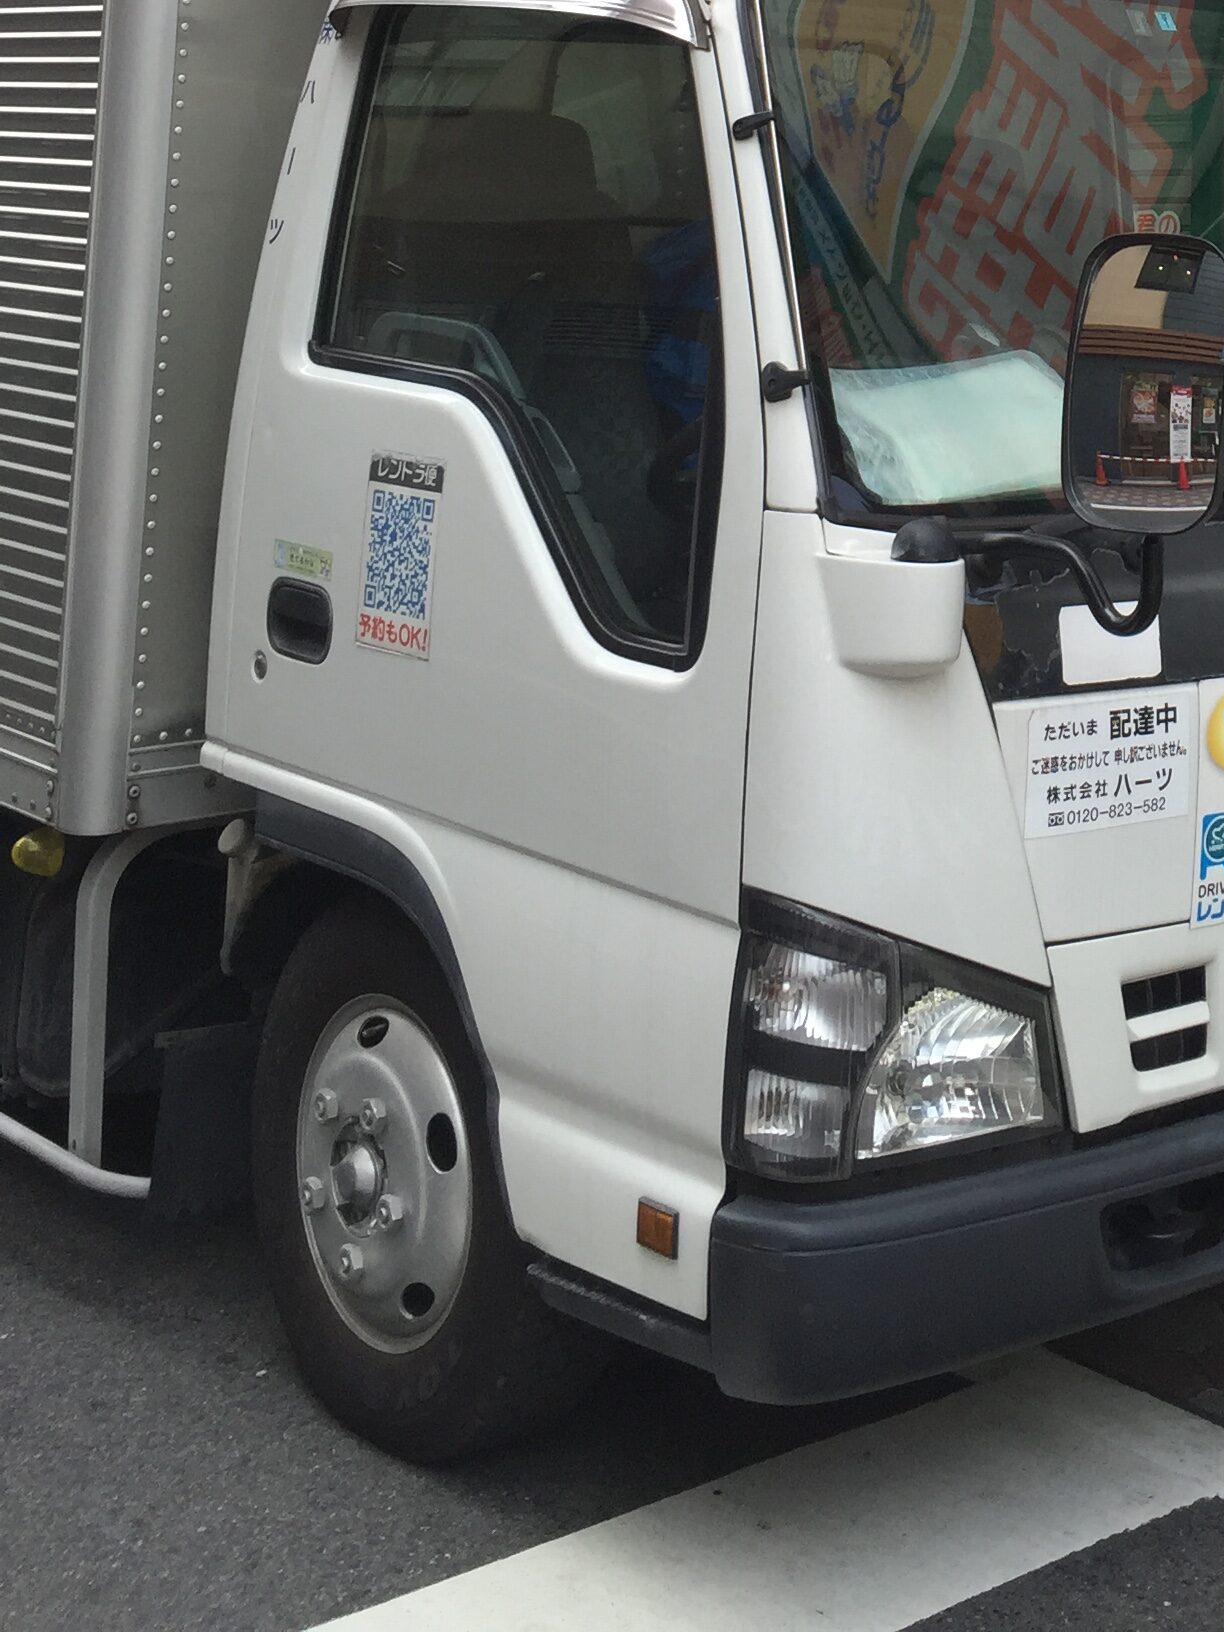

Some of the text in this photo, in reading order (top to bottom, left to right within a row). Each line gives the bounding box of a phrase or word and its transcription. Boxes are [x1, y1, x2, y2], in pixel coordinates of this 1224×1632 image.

[375, 456, 438, 487] レントラ便
[1043, 702, 1178, 741] ただいま 配達中
[1046, 767, 1173, 805] 株式会社 ハーツ
[1066, 796, 1167, 826] 0120-823-582
